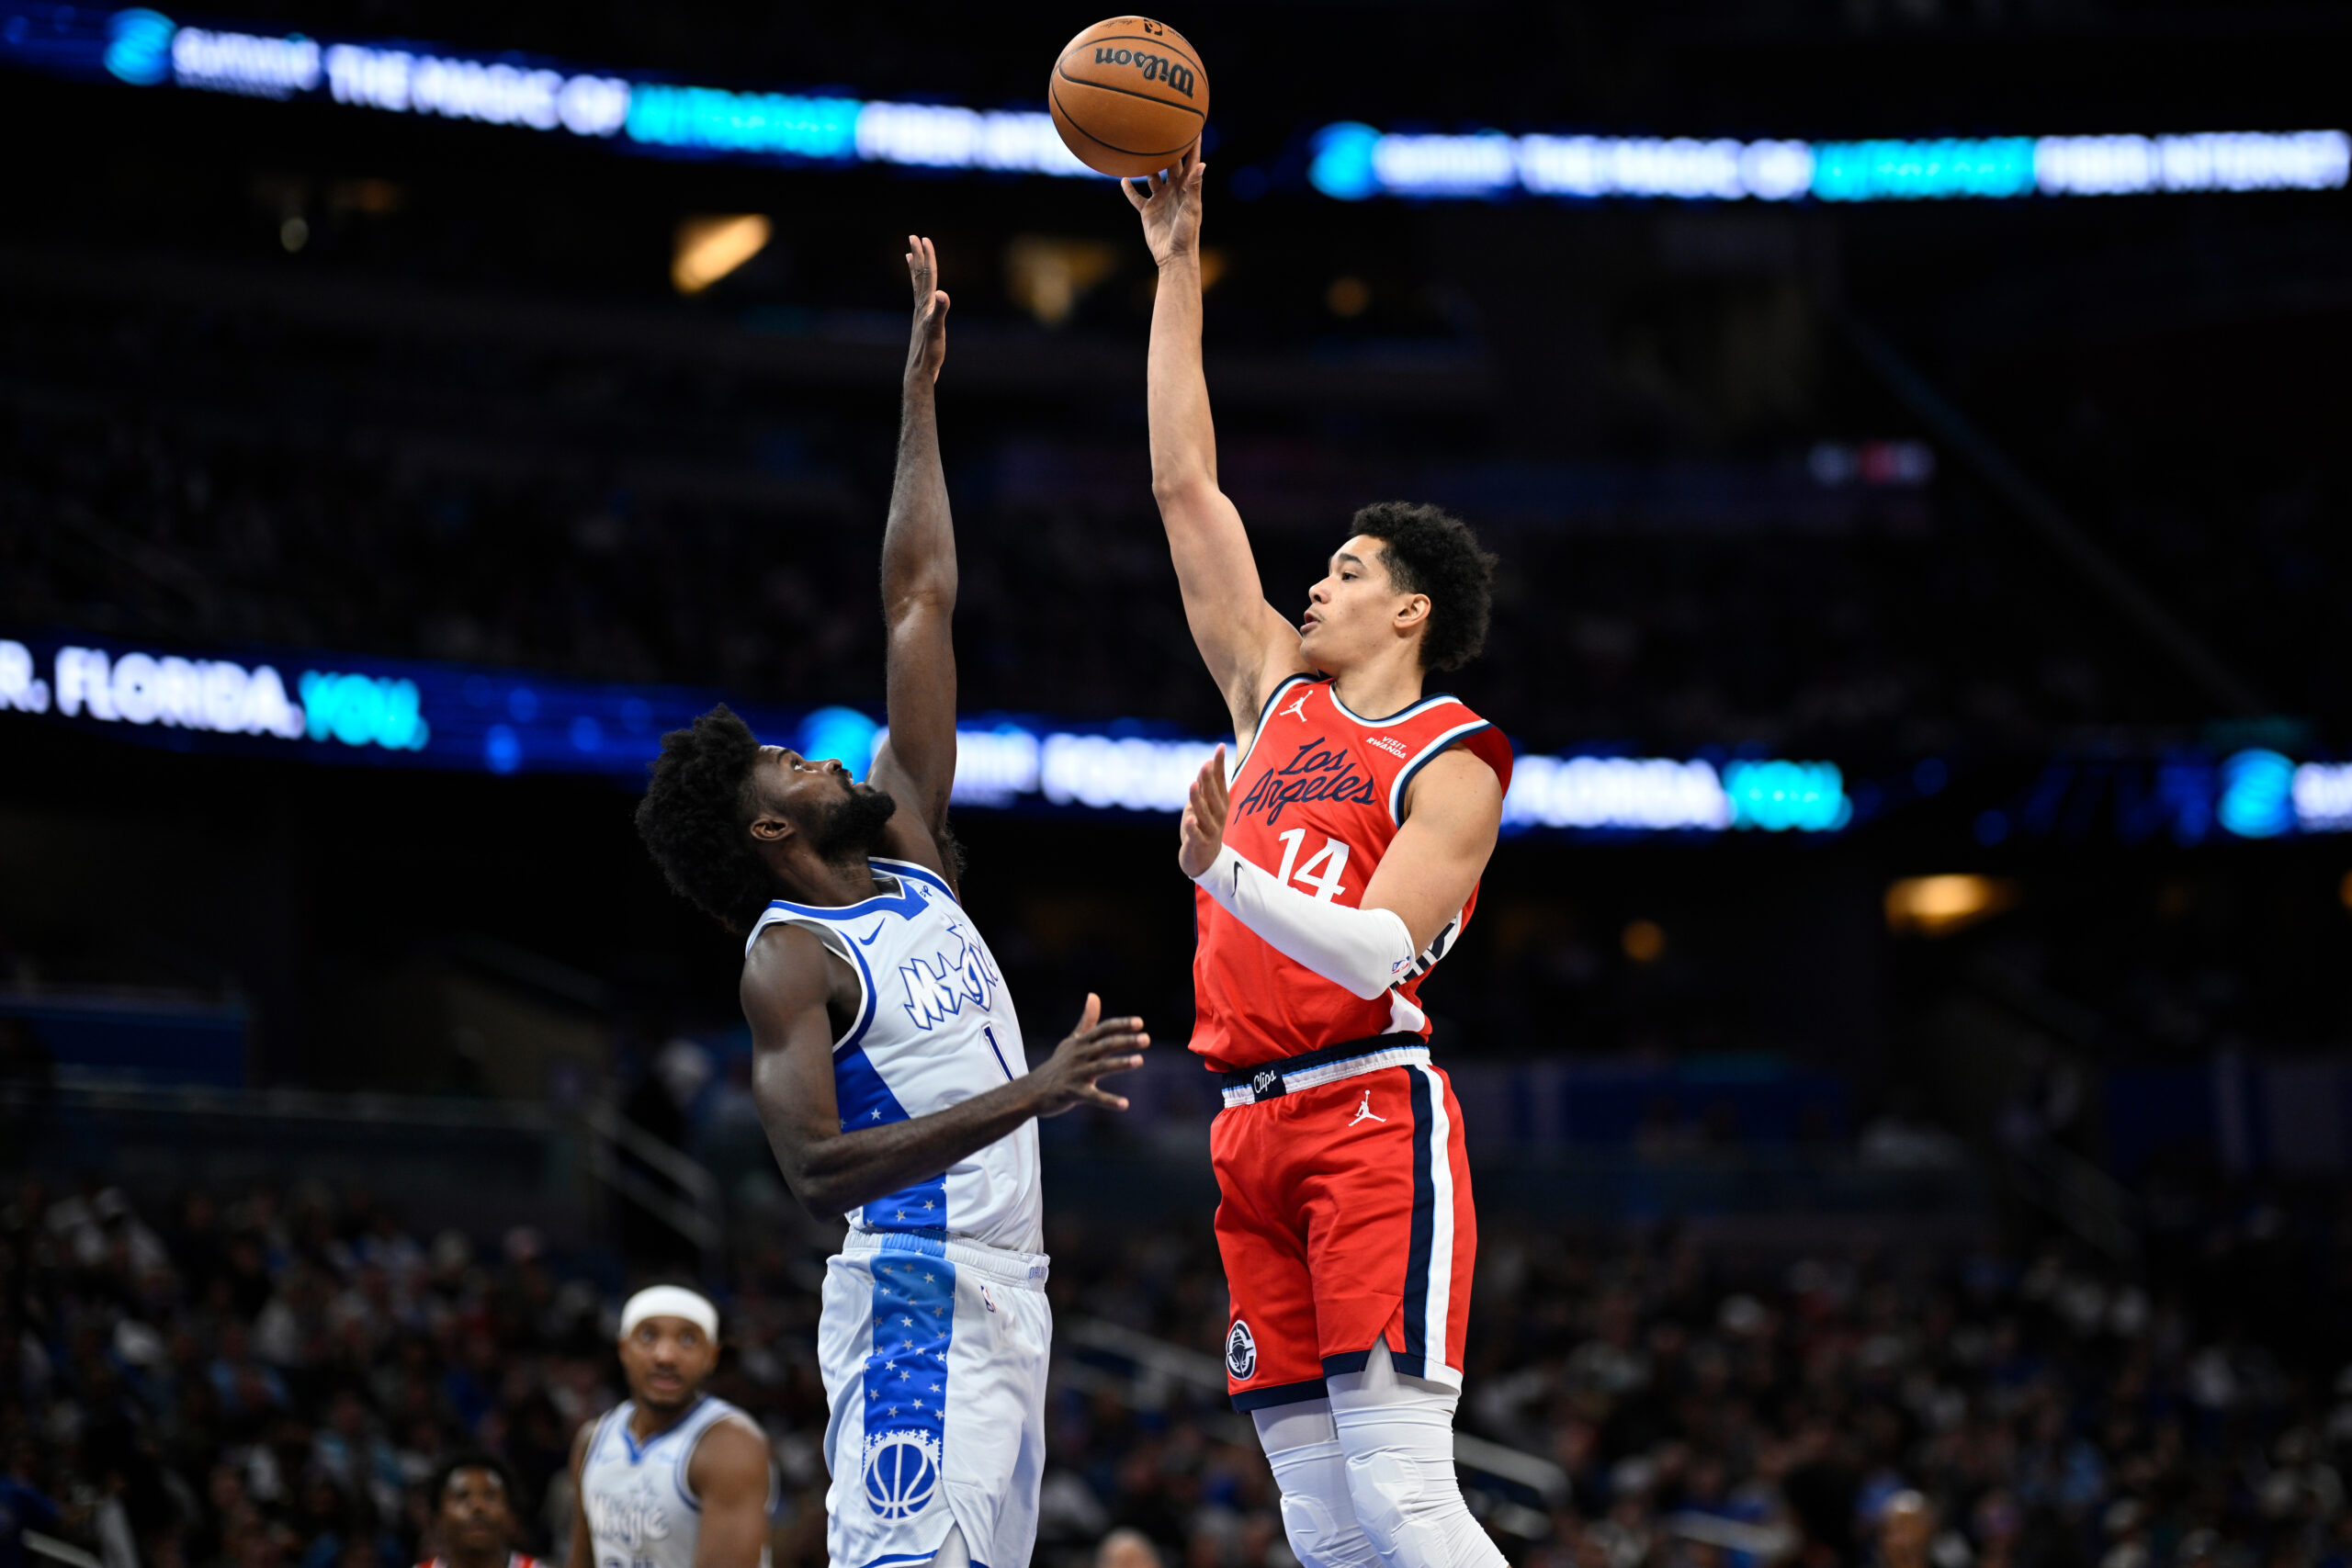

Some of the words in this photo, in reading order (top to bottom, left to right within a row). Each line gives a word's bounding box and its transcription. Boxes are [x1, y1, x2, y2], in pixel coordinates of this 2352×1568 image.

[1095, 48, 1194, 100] Wilson
[1278, 737, 1348, 775] Los
[1365, 737, 1407, 759] RWANDA
[1382, 736, 1407, 750] VISIT
[1234, 762, 1377, 826] Angeles
[1277, 828, 1350, 903] 14
[1253, 1069, 1277, 1094] Clips
